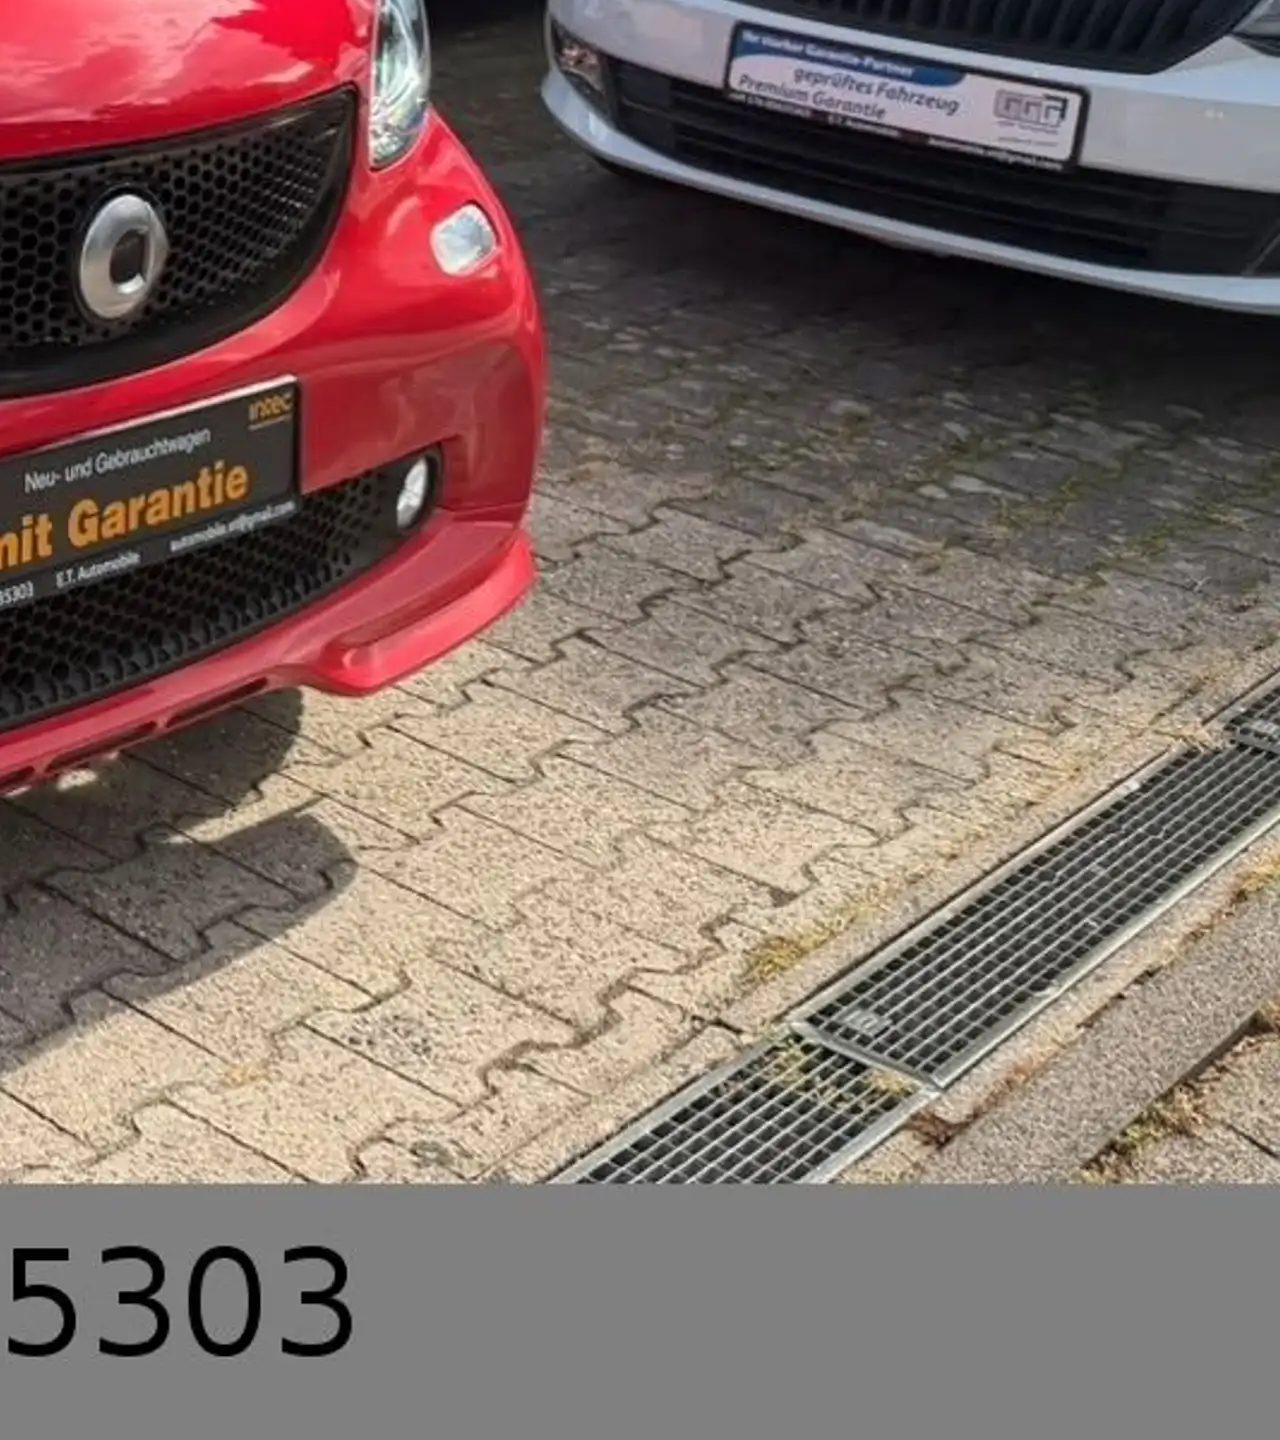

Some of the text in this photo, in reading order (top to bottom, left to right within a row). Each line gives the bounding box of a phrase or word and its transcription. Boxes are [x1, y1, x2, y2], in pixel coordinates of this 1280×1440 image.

[739, 73, 808, 102] Premium
[812, 91, 886, 120] Garantie
[793, 68, 959, 116] geprüftes Fahrzeug
[24, 428, 211, 494] Neu- und Gebrauchtwagen
[67, 460, 249, 548] Garantie
